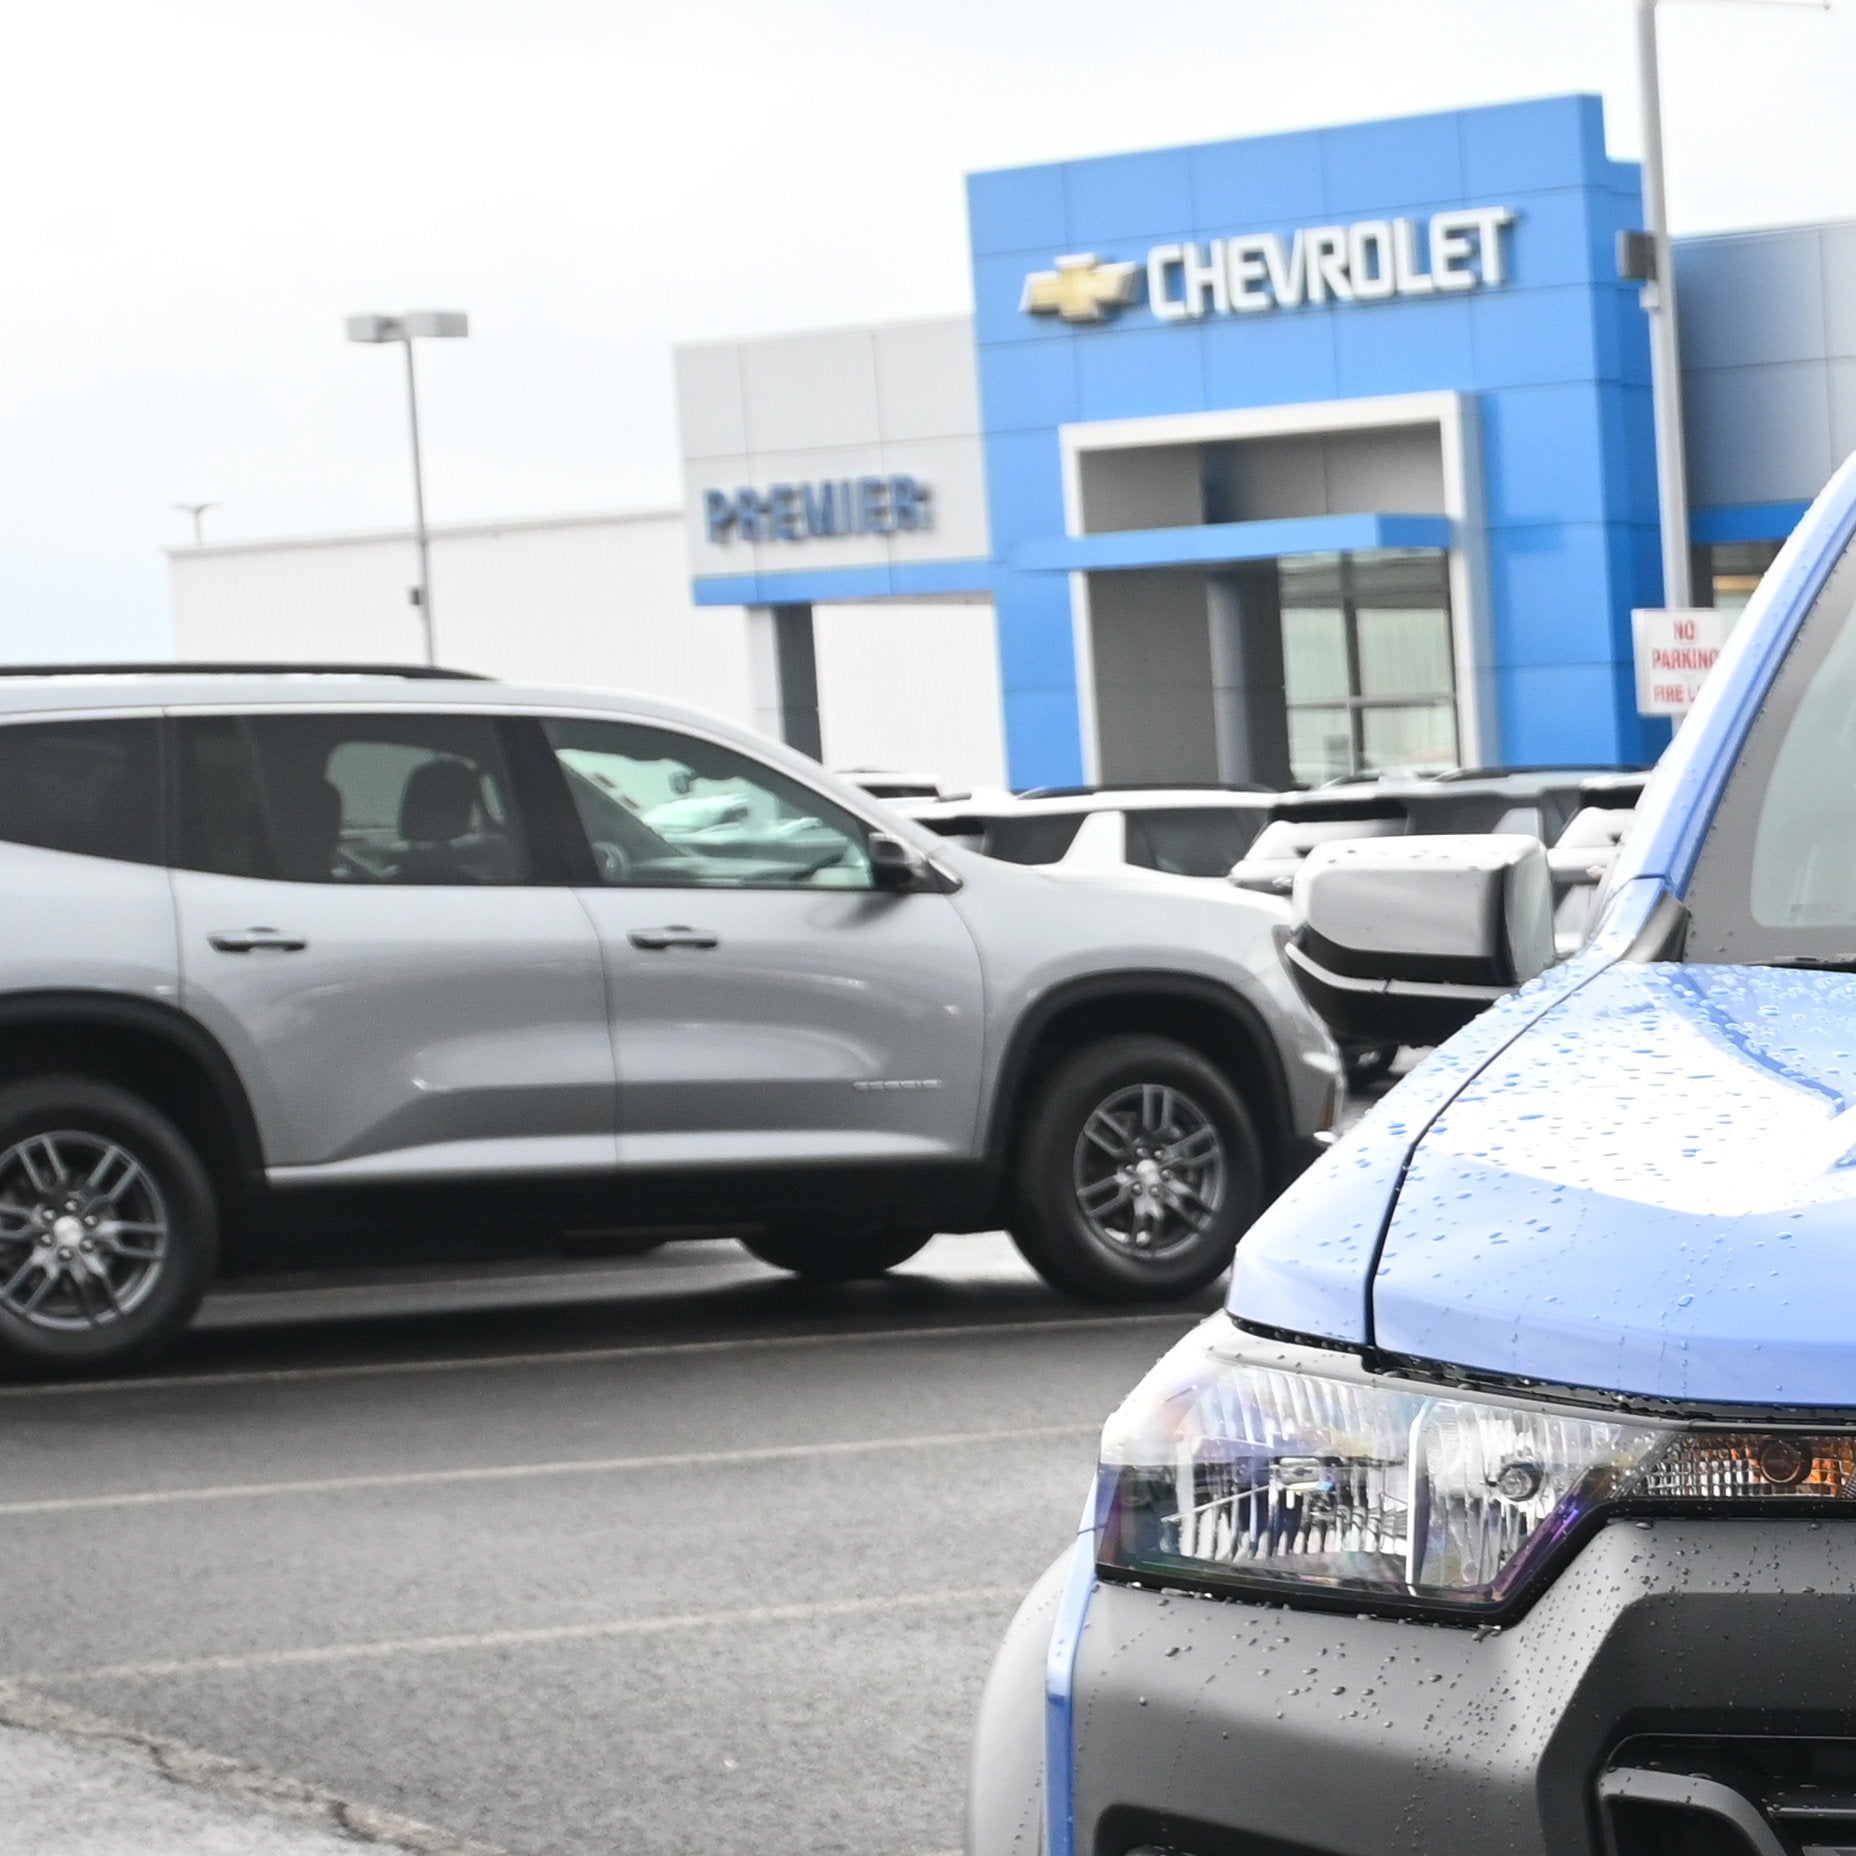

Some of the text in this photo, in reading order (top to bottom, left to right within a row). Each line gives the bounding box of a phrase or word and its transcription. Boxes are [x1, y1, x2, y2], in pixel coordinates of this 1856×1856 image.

[1147, 206, 1512, 321] CHEVROLET
[703, 474, 928, 544] PREMIER
[1673, 619, 1695, 641] NO
[1653, 684, 1683, 702] FIRE
